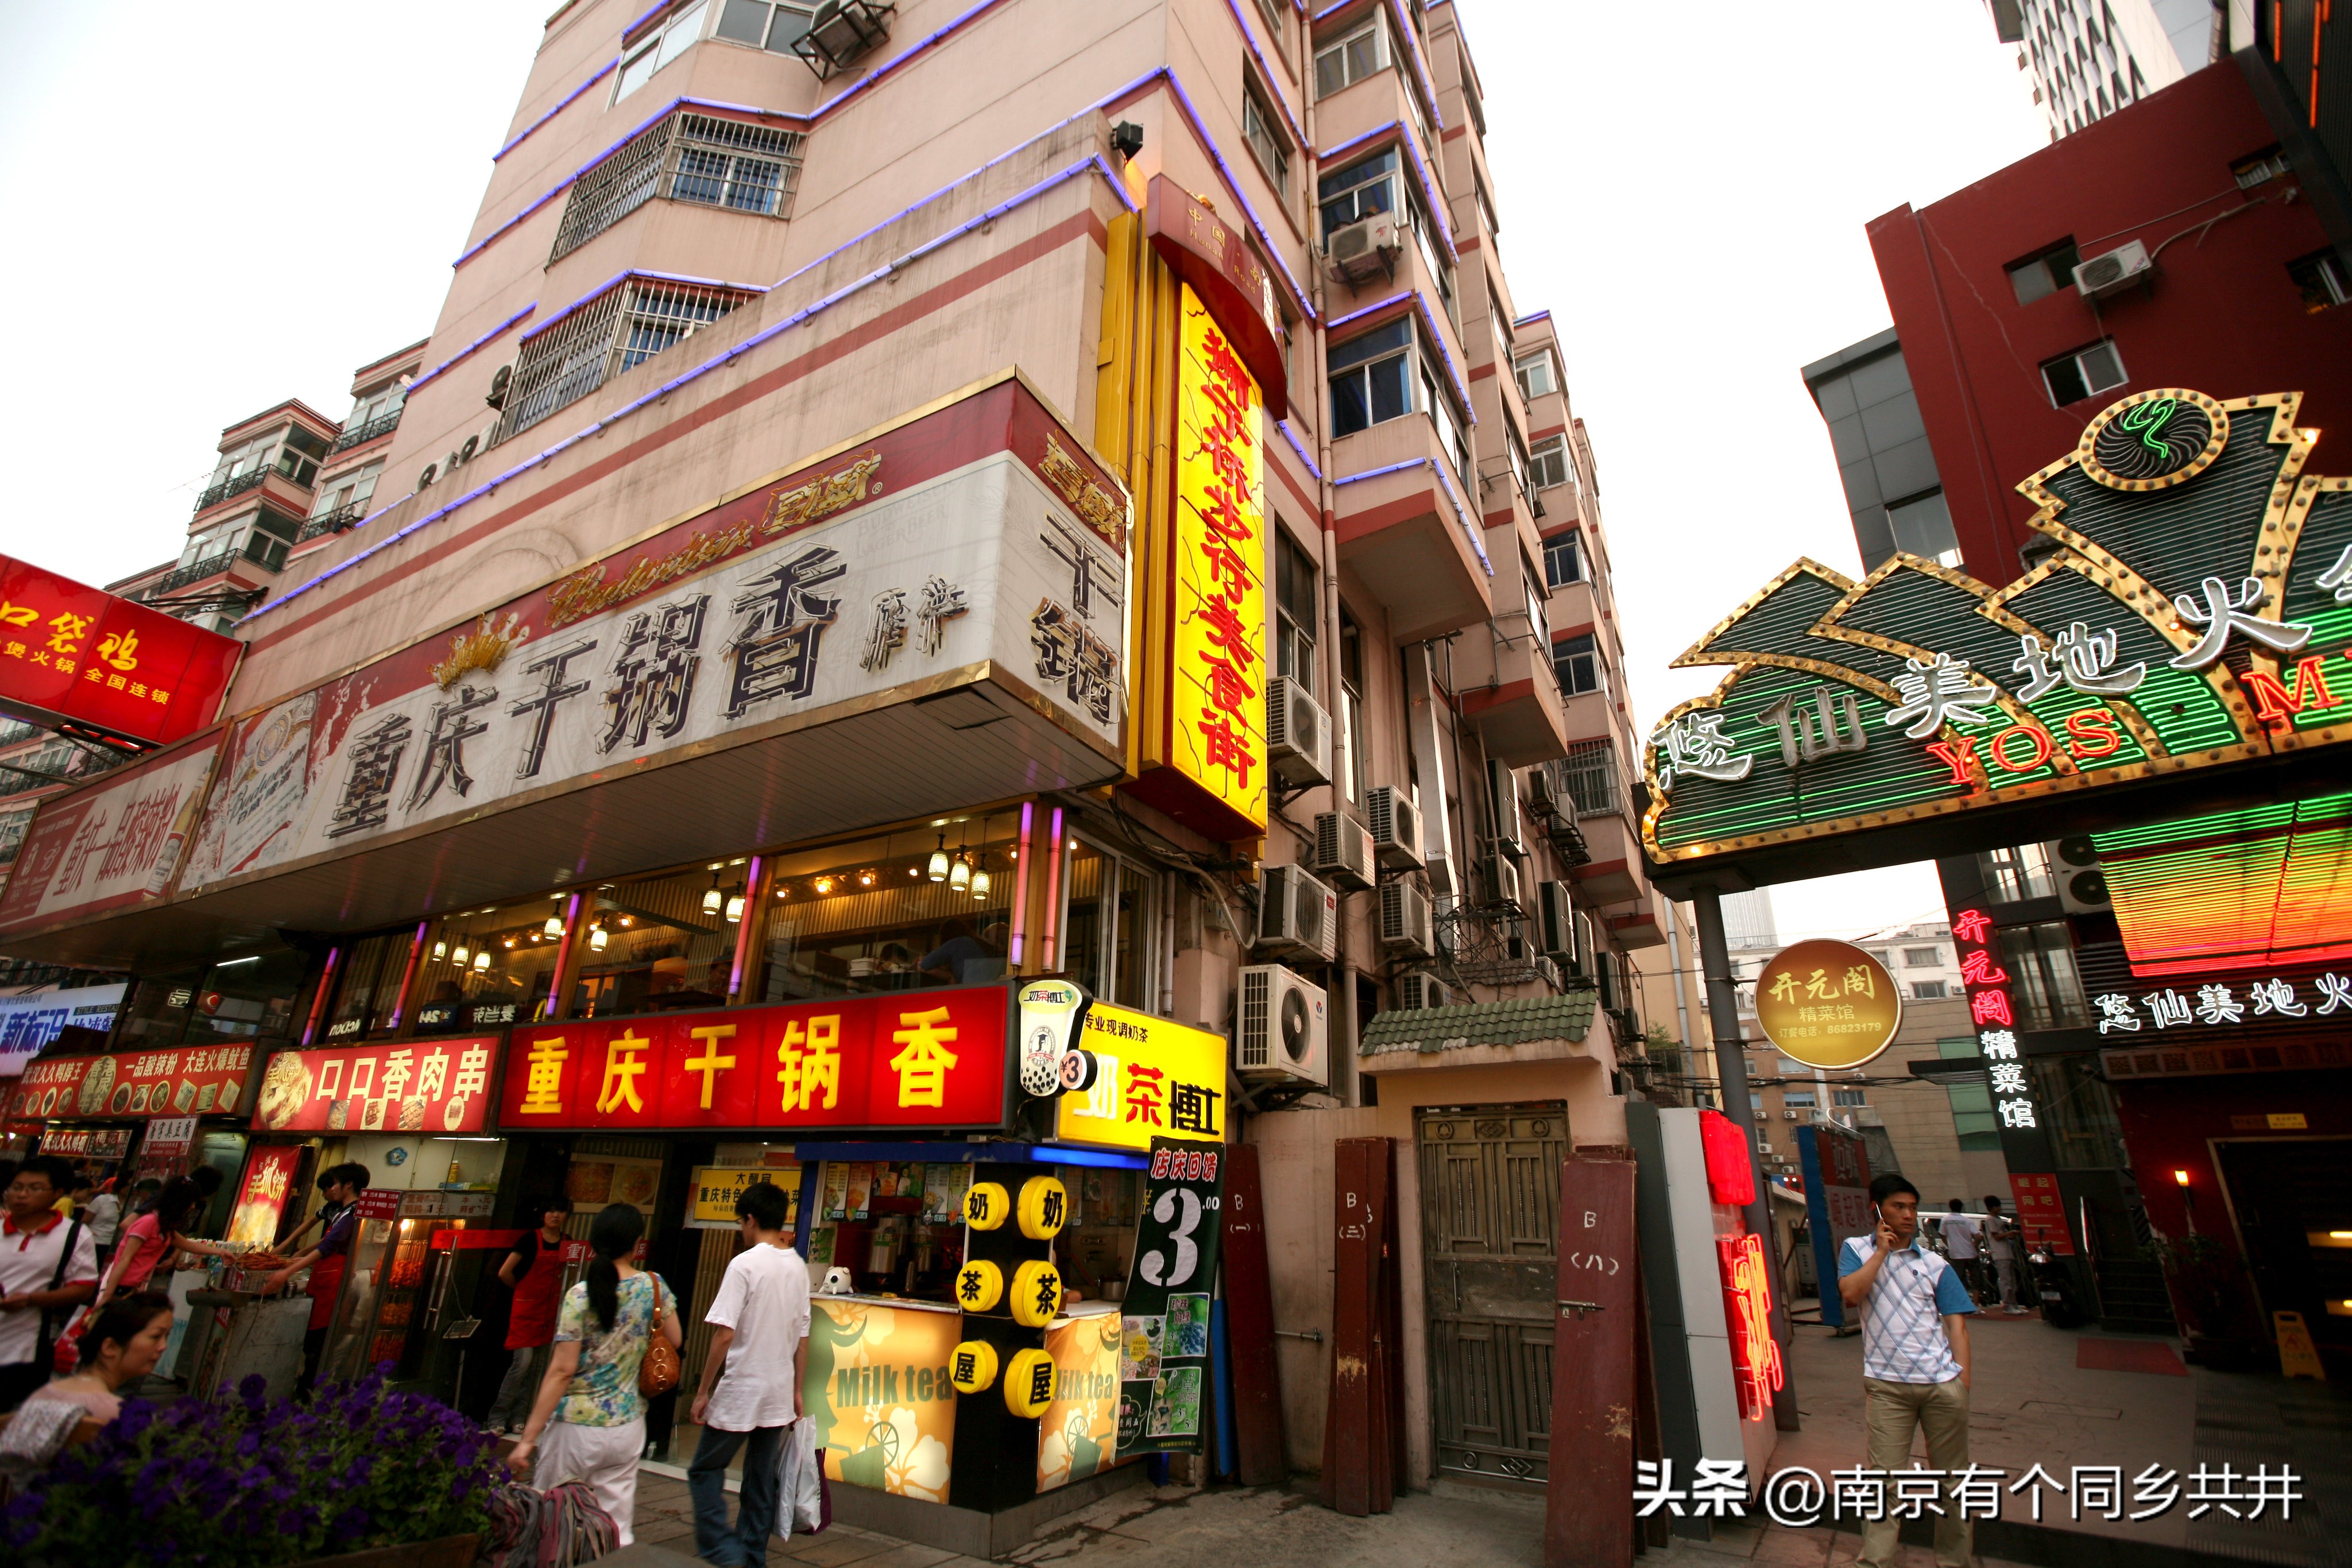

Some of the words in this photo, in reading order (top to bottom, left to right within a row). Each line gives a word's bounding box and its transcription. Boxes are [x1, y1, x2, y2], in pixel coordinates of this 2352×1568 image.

[1189, 228, 1224, 261] Hunan
[1233, 264, 1256, 294] Road
[1198, 327, 1257, 790] 狮子桥步行美食街
[0, 601, 139, 671] 口袋鸡
[1031, 513, 1126, 726] 干锅
[4, 641, 76, 674] 煲火锅
[84, 668, 170, 705] 全国连锁
[323, 541, 848, 839] 重庆干锅香
[2241, 649, 2352, 721] M
[52, 783, 182, 896] 重庆一品酸辣粉
[1768, 964, 1875, 1005] 开元阁
[1953, 909, 2014, 1026] 开元阁
[76, 1006, 95, 1016] STYLE
[1085, 1012, 1148, 1043] 专业现调奶茶
[1798, 1004, 1855, 1023] 精菜馆
[1827, 1022, 1882, 1034] 86823179
[2094, 972, 2352, 1033] 悠仙美地火
[21, 1061, 84, 1085] 武汉久久鸭脖王
[125, 1052, 179, 1078] 一品酸辣粉
[183, 1046, 252, 1074] 大连火爆鱿鱼
[315, 1043, 489, 1102] 口口香肉串
[520, 1006, 958, 1114] 重庆干锅香
[1061, 1056, 1080, 1083] ¥3
[1980, 1030, 2036, 1129] 精菜馆
[247, 1157, 288, 1205] 手抓饼
[1150, 1147, 1218, 1183] 店庆回馈
[1233, 1194, 1244, 1211] B
[1346, 1192, 1357, 1209] B
[1583, 1211, 1598, 1229] B
[2021, 1195, 2054, 1206] 网吧
[953, 1191, 990, 1384] 奶茶屋
[1029, 1190, 1063, 1406] 奶茶屋
[837, 1364, 899, 1408] Milk
[904, 1364, 951, 1403] tea
[1087, 1371, 1114, 1399] tea
